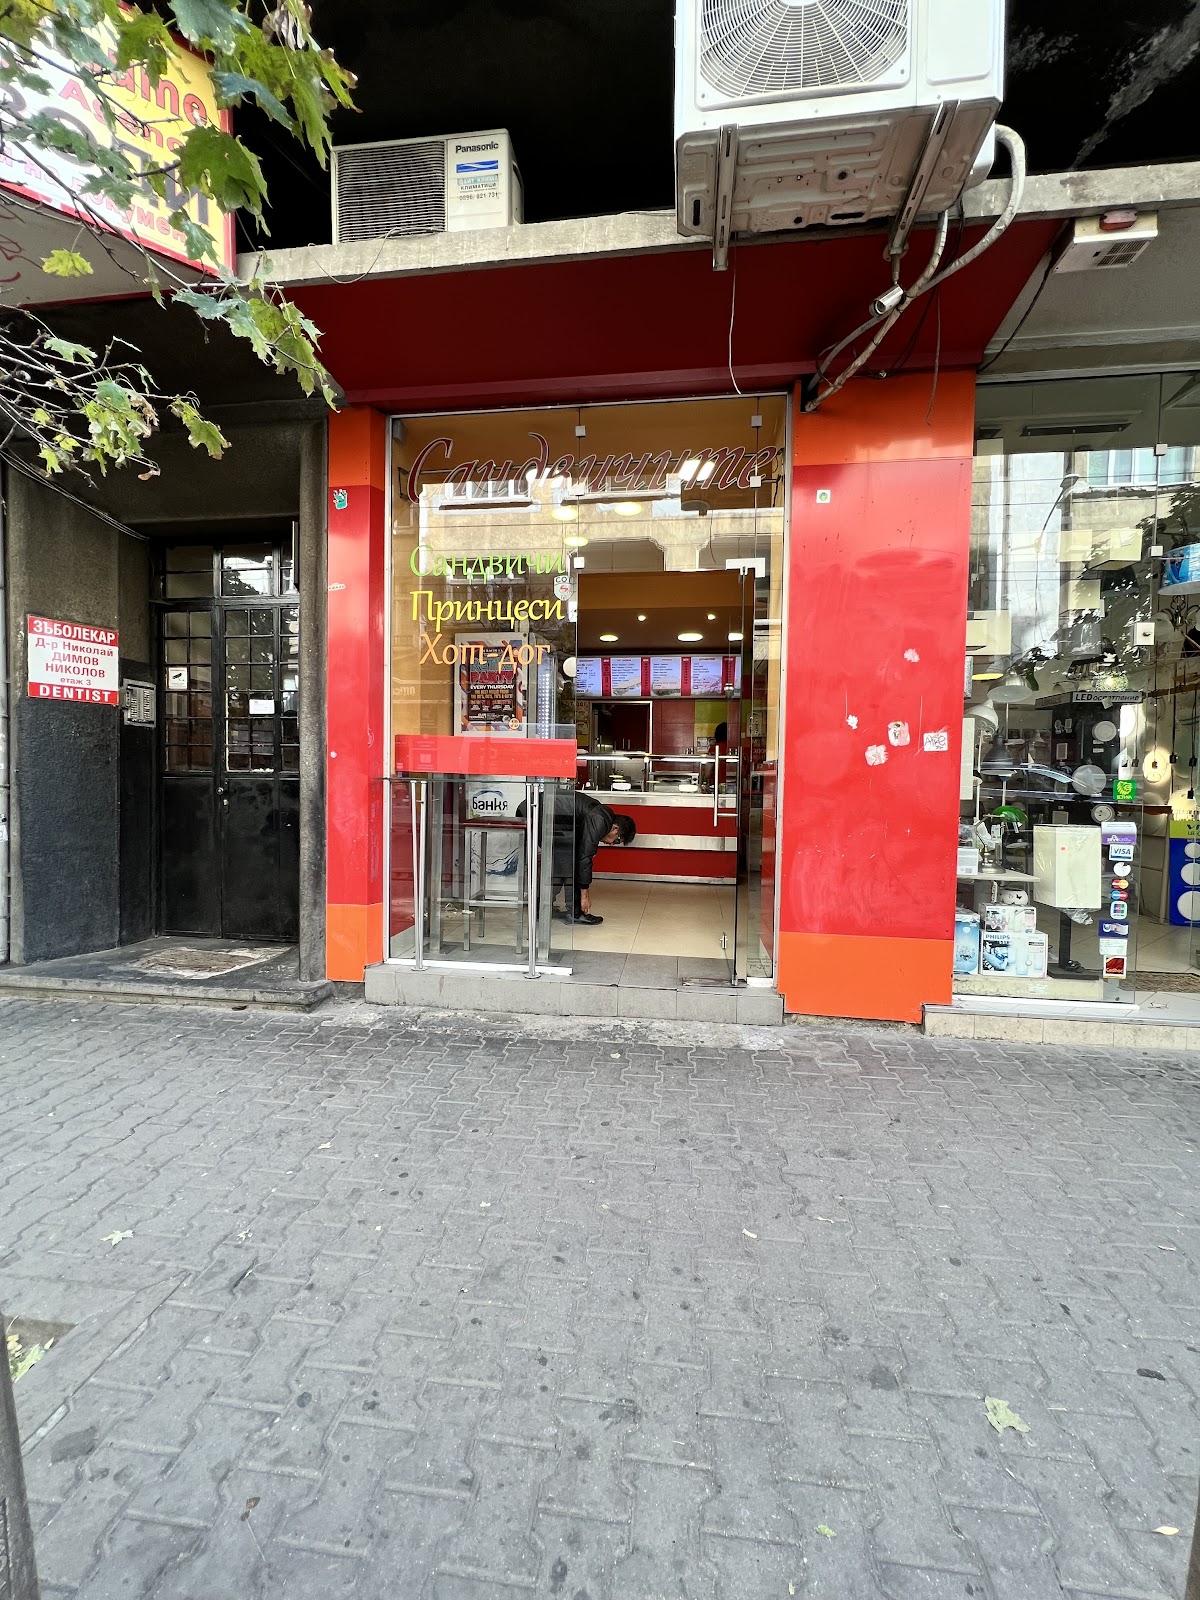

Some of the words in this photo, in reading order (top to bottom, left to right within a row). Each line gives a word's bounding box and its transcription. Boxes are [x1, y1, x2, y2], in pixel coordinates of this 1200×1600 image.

[455, 141, 499, 154] Panasonic
[407, 431, 778, 505] Сандвичите
[409, 545, 567, 584] Сандвичи
[410, 590, 565, 632] Принцеси
[33, 619, 116, 644] ЗЪБОЛЕКАР
[35, 637, 58, 650] Д-р
[62, 640, 114, 657] Николай
[418, 633, 551, 673] Хот-дог
[51, 652, 99, 666] ДИМОВ
[45, 662, 106, 678] НИКОЛОВ
[470, 671, 515, 685] PARTY
[60, 677, 84, 686] етаж
[39, 684, 111, 702] DENTIST
[1075, 693, 1093, 701] LED
[472, 796, 508, 811] банкя
